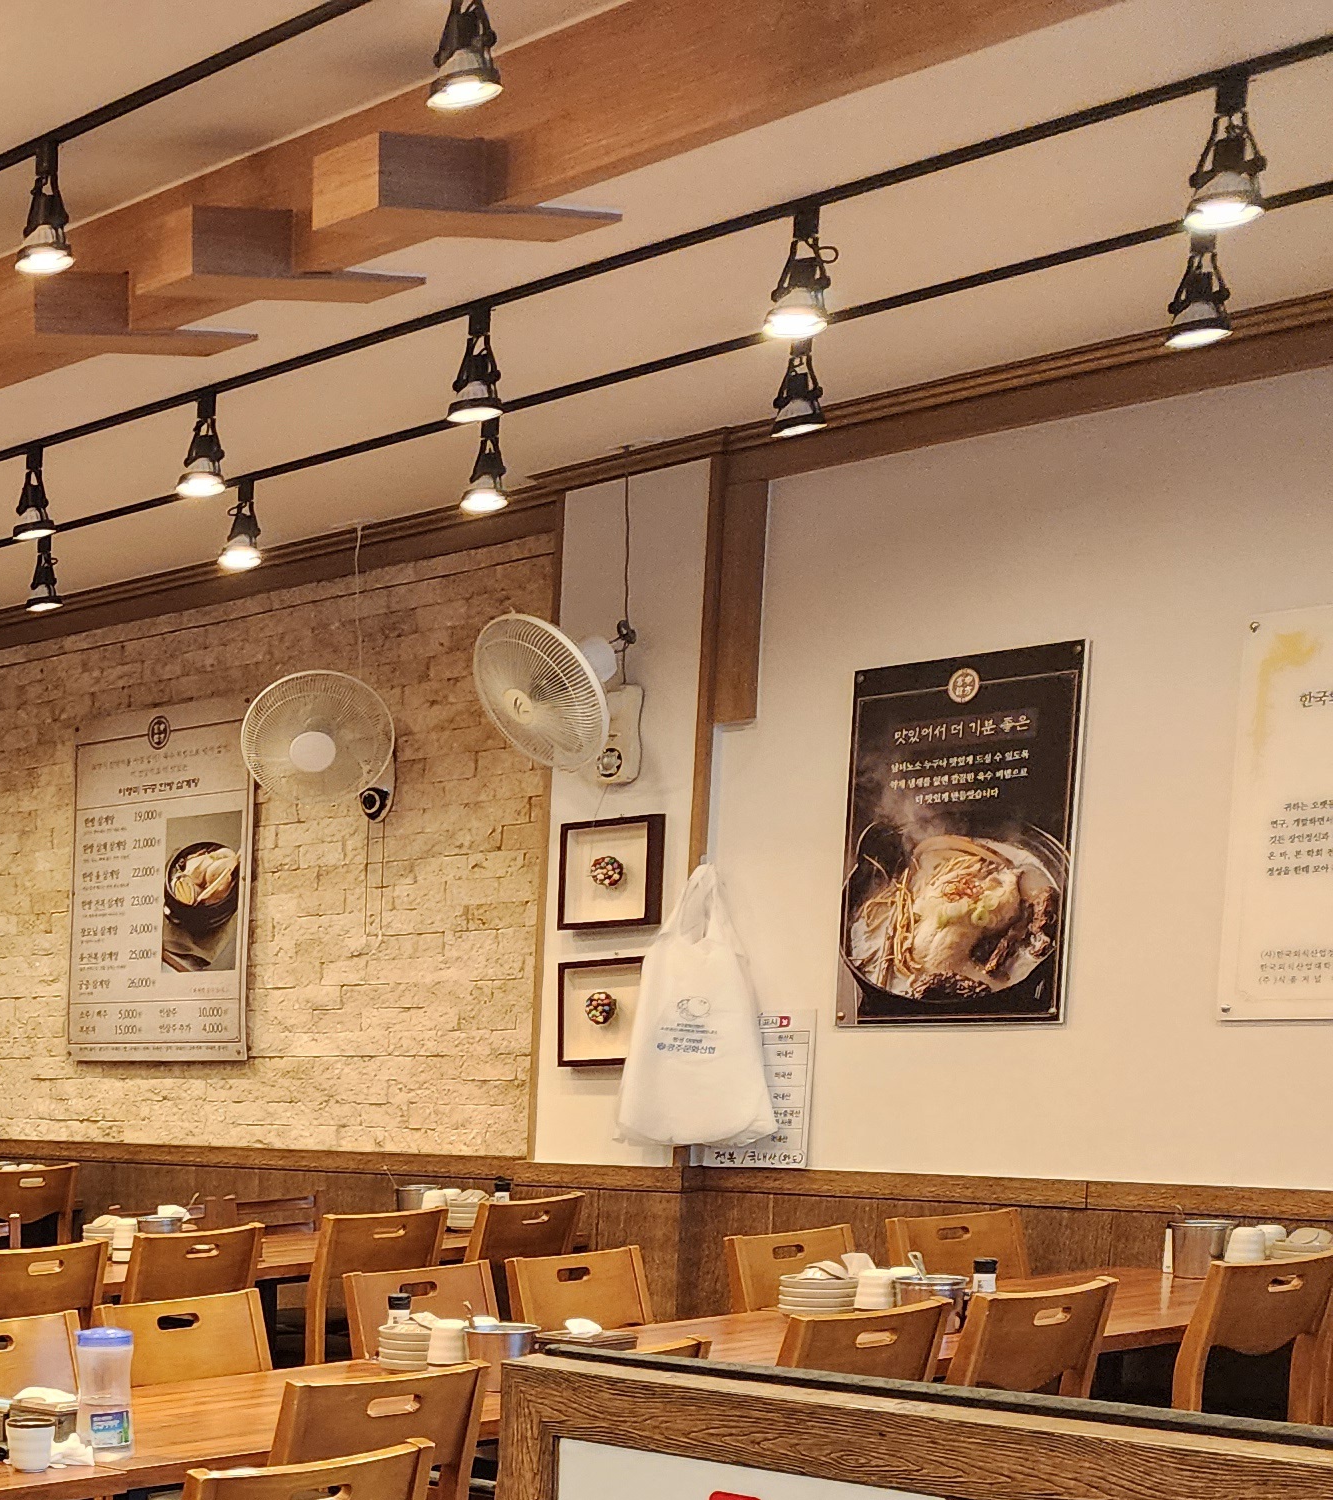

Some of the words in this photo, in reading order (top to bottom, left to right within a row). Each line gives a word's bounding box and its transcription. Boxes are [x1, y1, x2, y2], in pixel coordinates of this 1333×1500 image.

[894, 722, 947, 746] 맛있어서
[950, 720, 964, 739] 더
[969, 718, 997, 737] 기분
[999, 714, 1031, 733] 좋은
[1312, 863, 1329, 873] 모아
[714, 1150, 737, 1164] 전복
